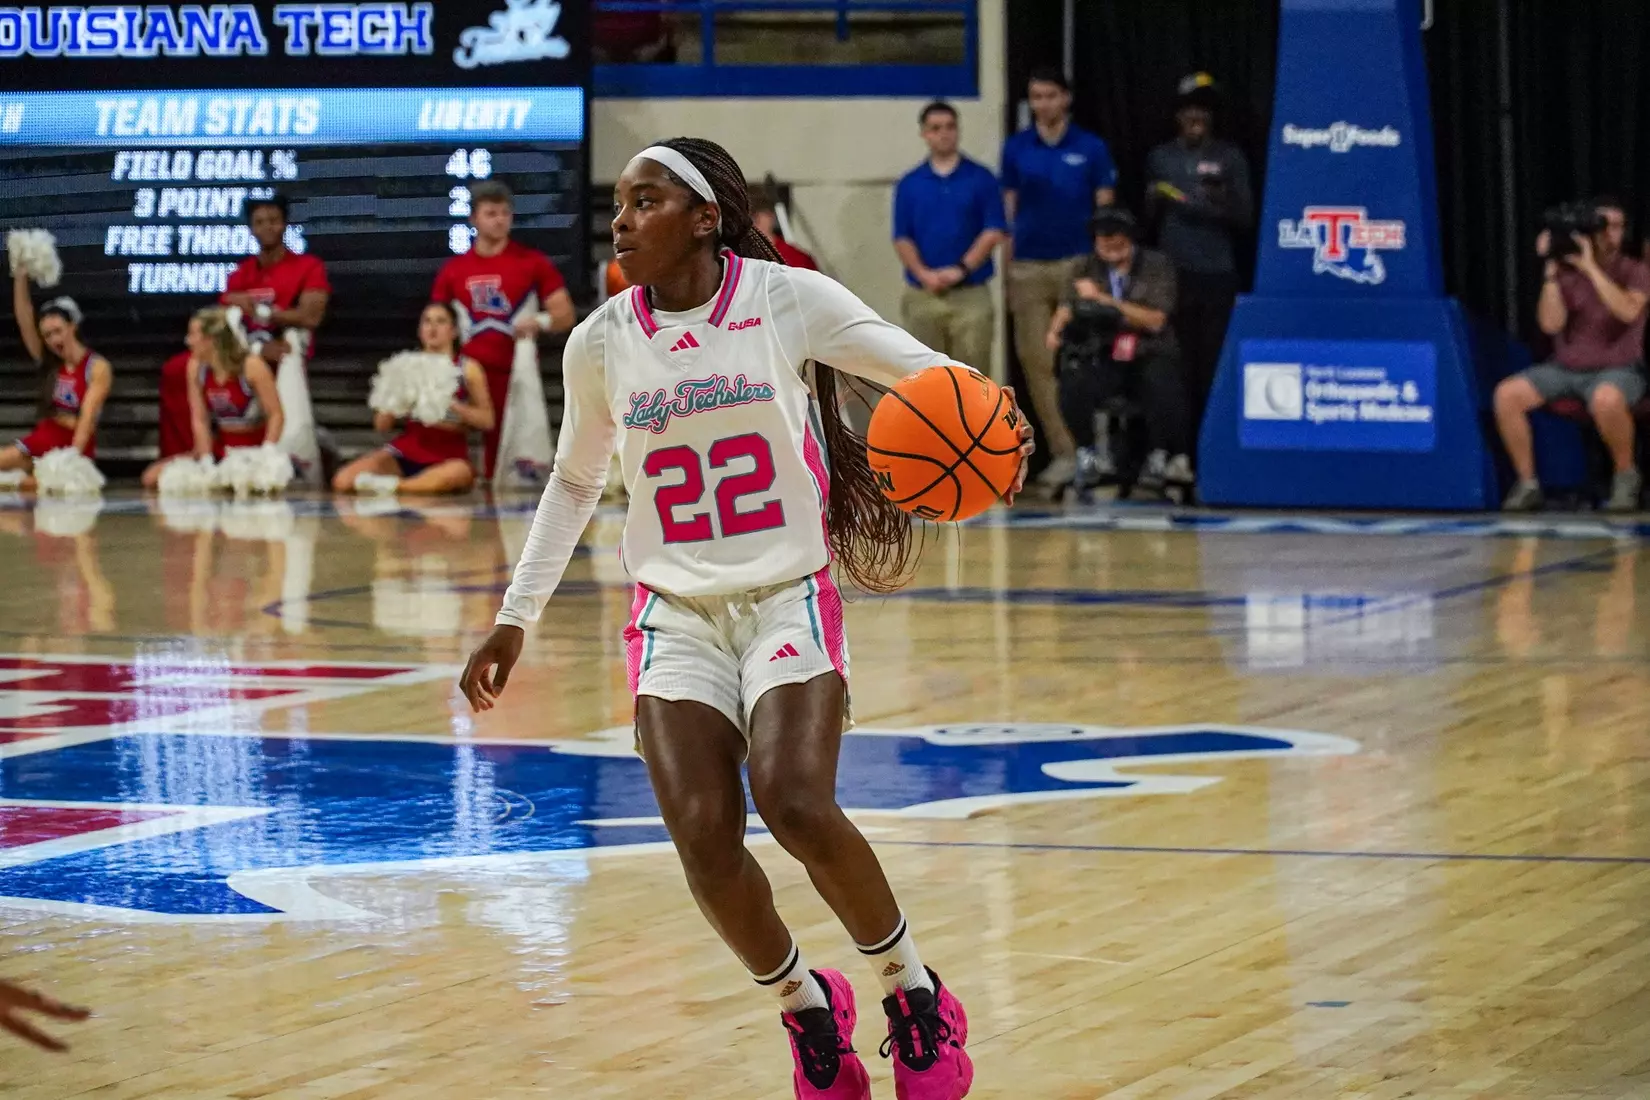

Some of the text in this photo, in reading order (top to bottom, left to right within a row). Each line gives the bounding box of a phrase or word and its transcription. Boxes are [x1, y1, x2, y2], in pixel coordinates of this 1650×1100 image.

[273, 3, 433, 54] TECH
[95, 96, 320, 136] TEAM STATS
[418, 99, 533, 130] LIBERTY
[111, 149, 298, 180] FIELD GOAL %
[445, 148, 492, 179] 46
[134, 187, 156, 218] 3
[157, 187, 248, 218] POINT
[104, 225, 174, 255] FREE
[177, 225, 261, 255] THRO
[623, 374, 776, 434] Lady Techsters
[642, 432, 786, 545] 22
